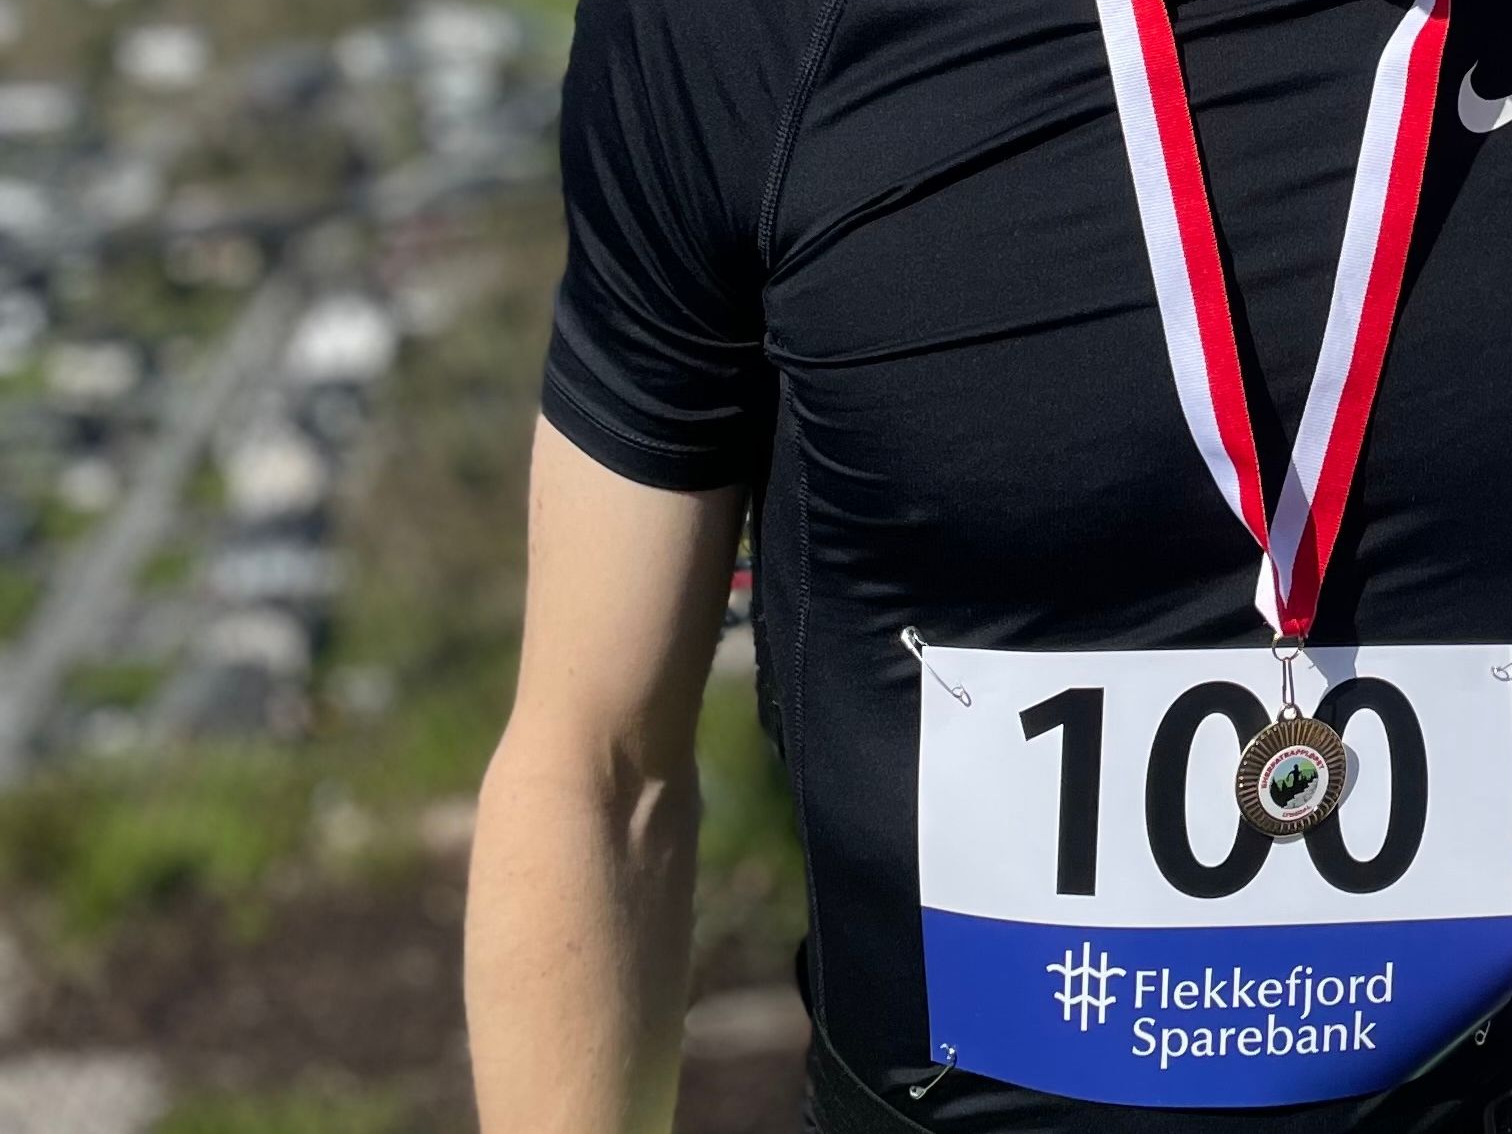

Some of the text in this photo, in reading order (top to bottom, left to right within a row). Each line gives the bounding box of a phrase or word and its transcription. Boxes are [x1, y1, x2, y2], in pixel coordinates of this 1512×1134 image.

[1019, 676, 1428, 899] 100
[1133, 961, 1394, 1020] Flekkefjord
[1131, 1010, 1377, 1070] Sparebank
